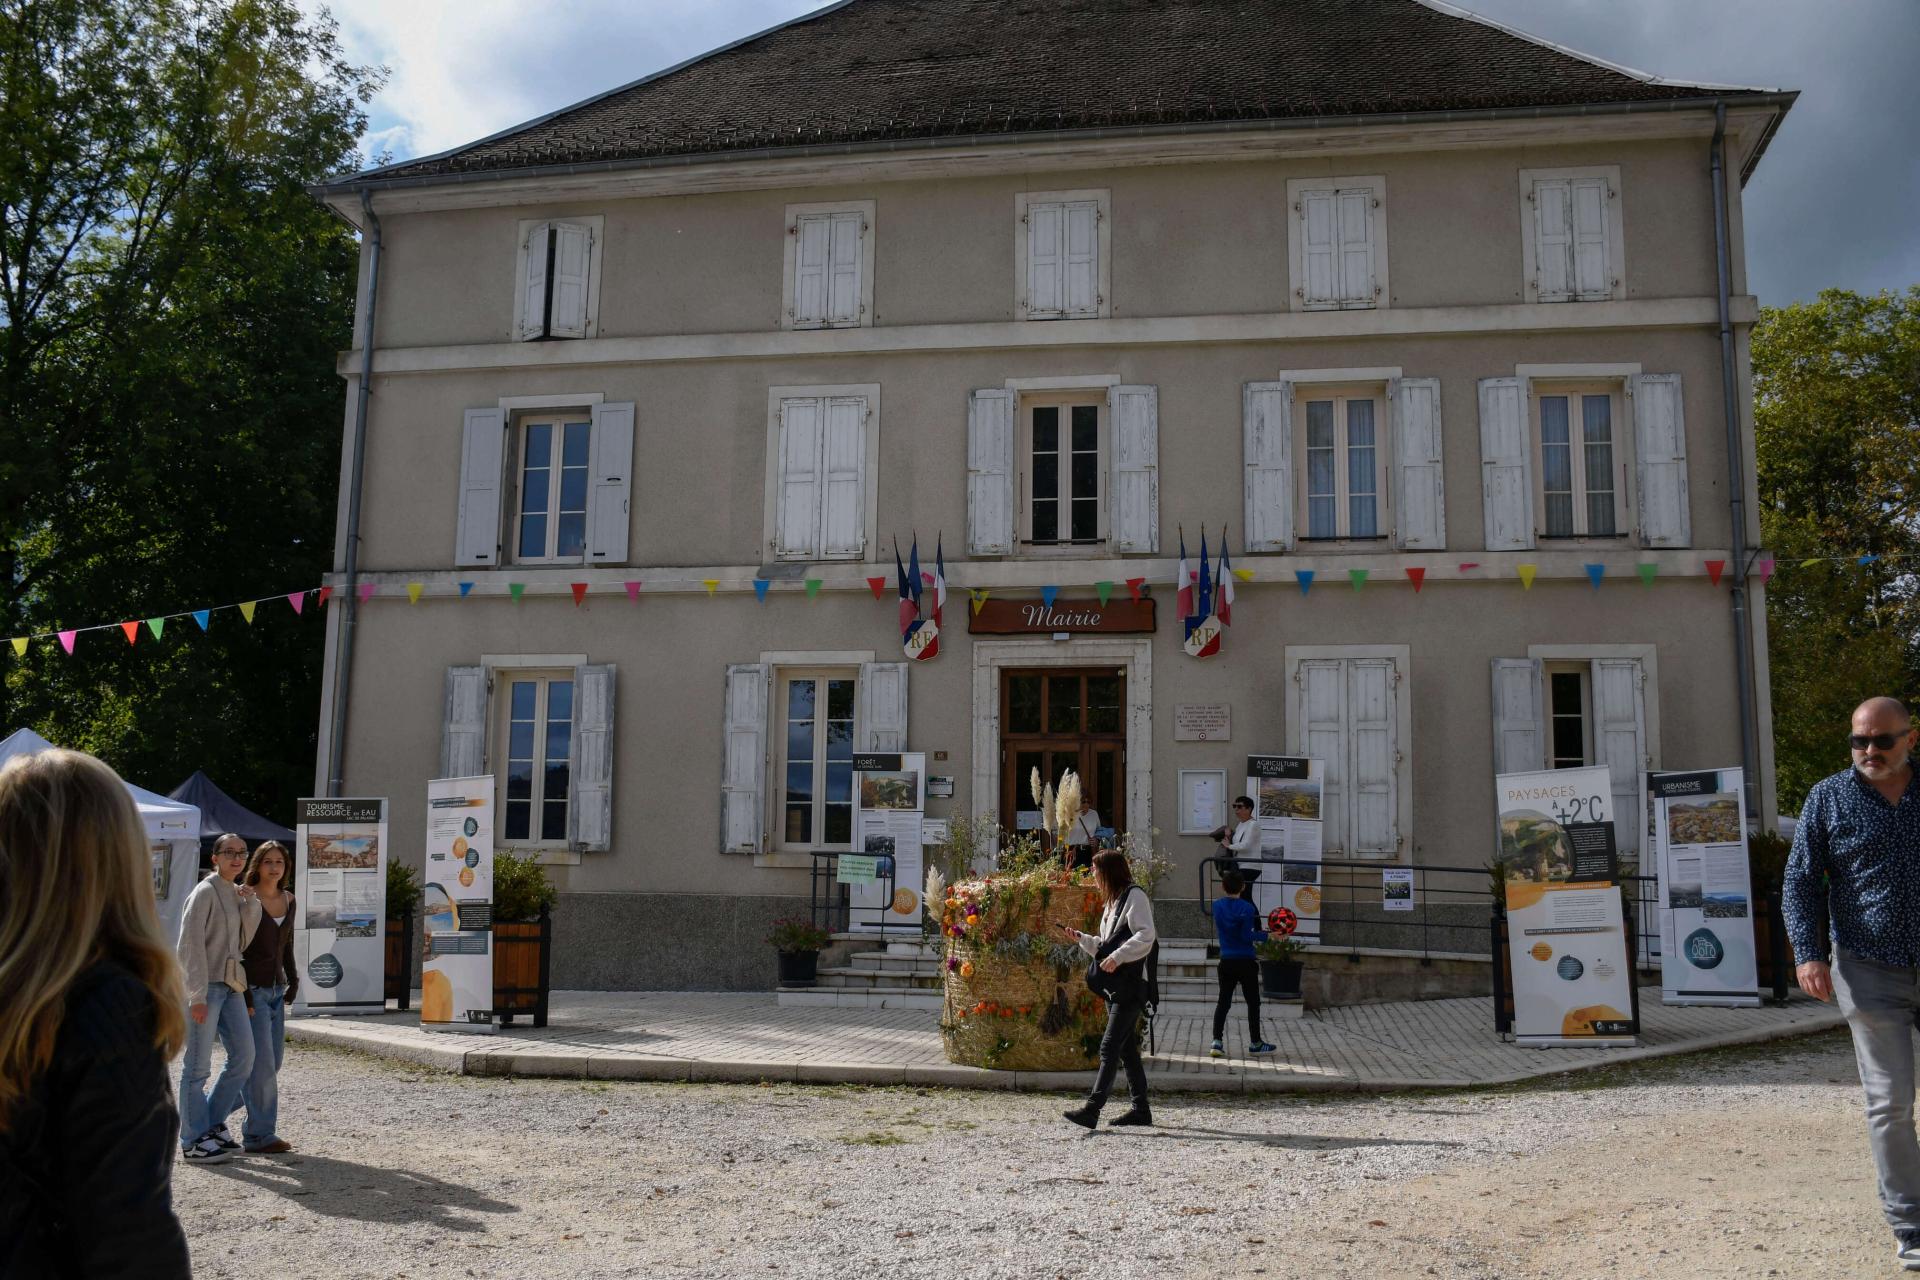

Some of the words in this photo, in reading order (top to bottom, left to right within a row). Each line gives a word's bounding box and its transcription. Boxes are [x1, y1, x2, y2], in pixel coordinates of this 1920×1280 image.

[1022, 604, 1101, 627] Mairie
[910, 631, 932, 649] RF
[1191, 628, 1215, 645] RF
[1256, 760, 1299, 768] AGRICULTURE
[1508, 784, 1576, 801] PAYSAGES
[1662, 780, 1701, 791] URBANISME
[306, 809, 351, 817] RESSOURCE
[1556, 795, 1604, 825] +2°C
